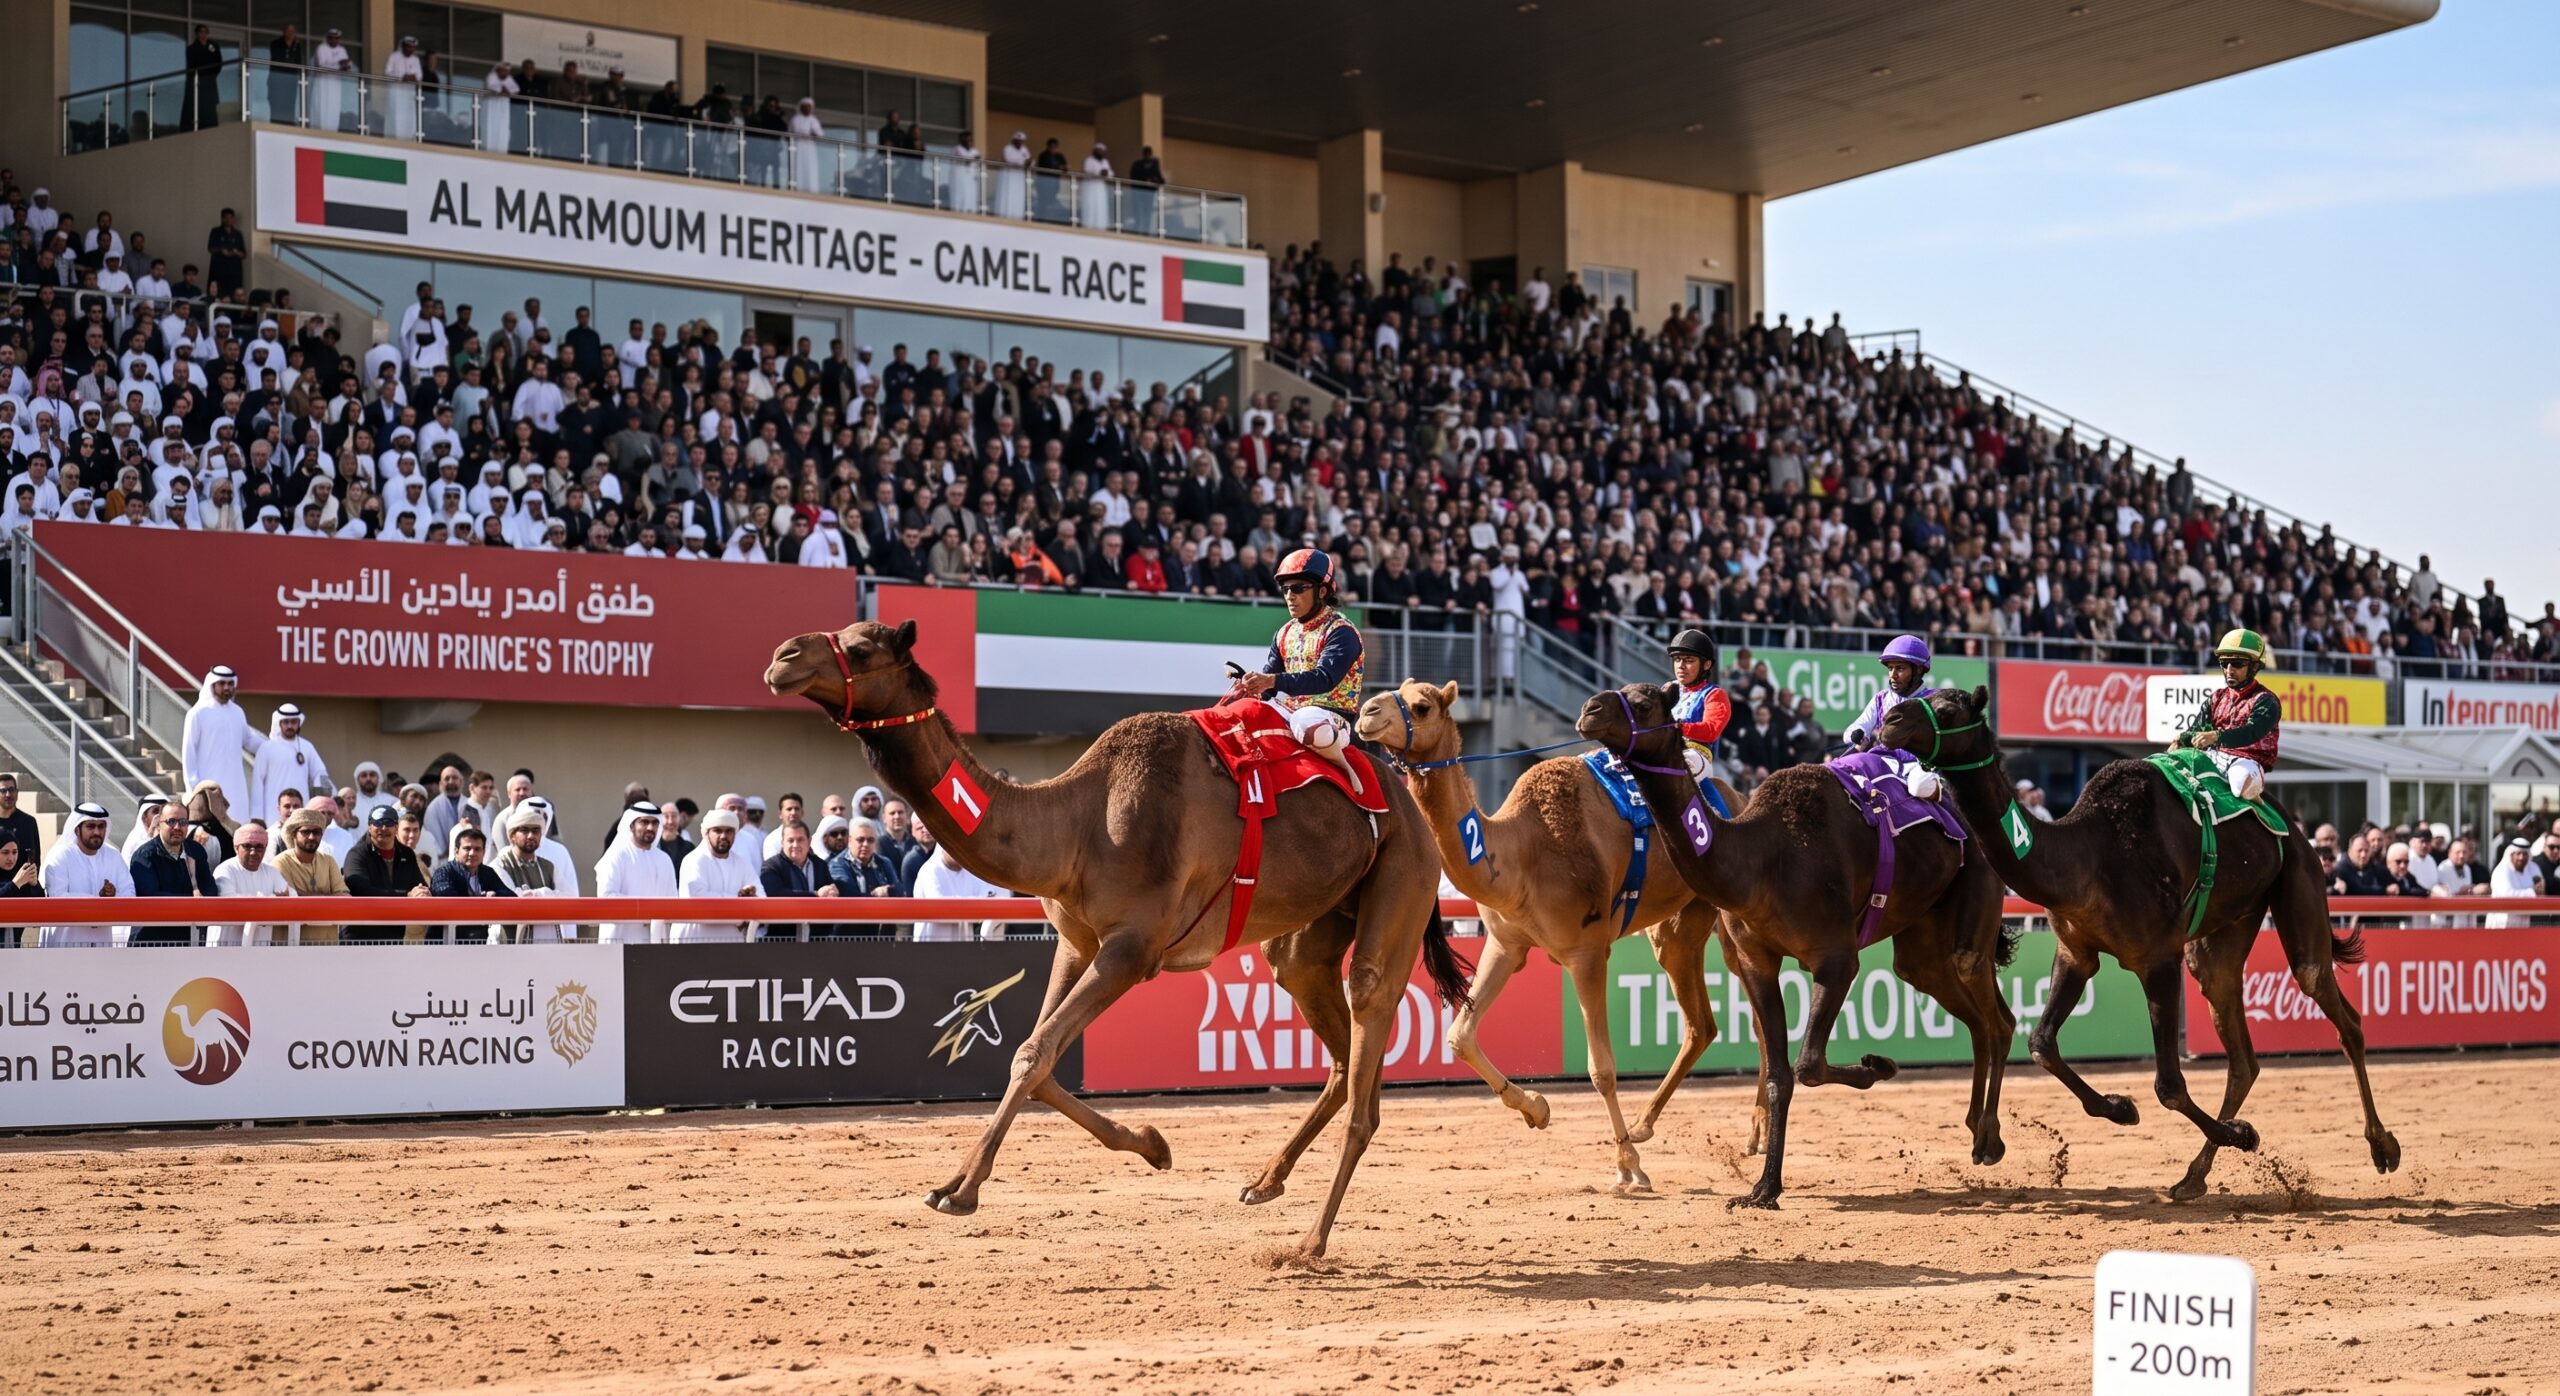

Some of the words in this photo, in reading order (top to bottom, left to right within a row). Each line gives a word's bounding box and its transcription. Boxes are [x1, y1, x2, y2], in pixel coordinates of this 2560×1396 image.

[430, 179, 481, 229] AL
[496, 187, 706, 254] MARMOUM
[721, 215, 898, 277] HERITAGE
[934, 241, 1051, 295] CAMEL
[1062, 256, 1147, 305] RACE
[277, 625, 327, 664] THE
[334, 628, 429, 668] CROWN
[438, 633, 553, 673] PRINCE'S
[559, 638, 654, 677] TROPHY
[2043, 669, 2145, 734] Coca-Cola
[2164, 688, 2213, 704] FINIS
[952, 777, 982, 819] 1
[1465, 817, 1484, 860] 2
[1688, 807, 1709, 846] 3
[2011, 808, 2031, 848] 4
[669, 977, 906, 1023] ETIHAD
[2357, 961, 2391, 1016] 10
[2401, 958, 2548, 1014] FURLONGS
[52, 1043, 146, 1080] Bank
[287, 1038, 408, 1069] CROWN
[418, 1036, 535, 1066] RACING
[722, 1035, 857, 1068] RACING
[2110, 1291, 2233, 1328] FINISH
[2130, 1342, 2231, 1379] 200m
